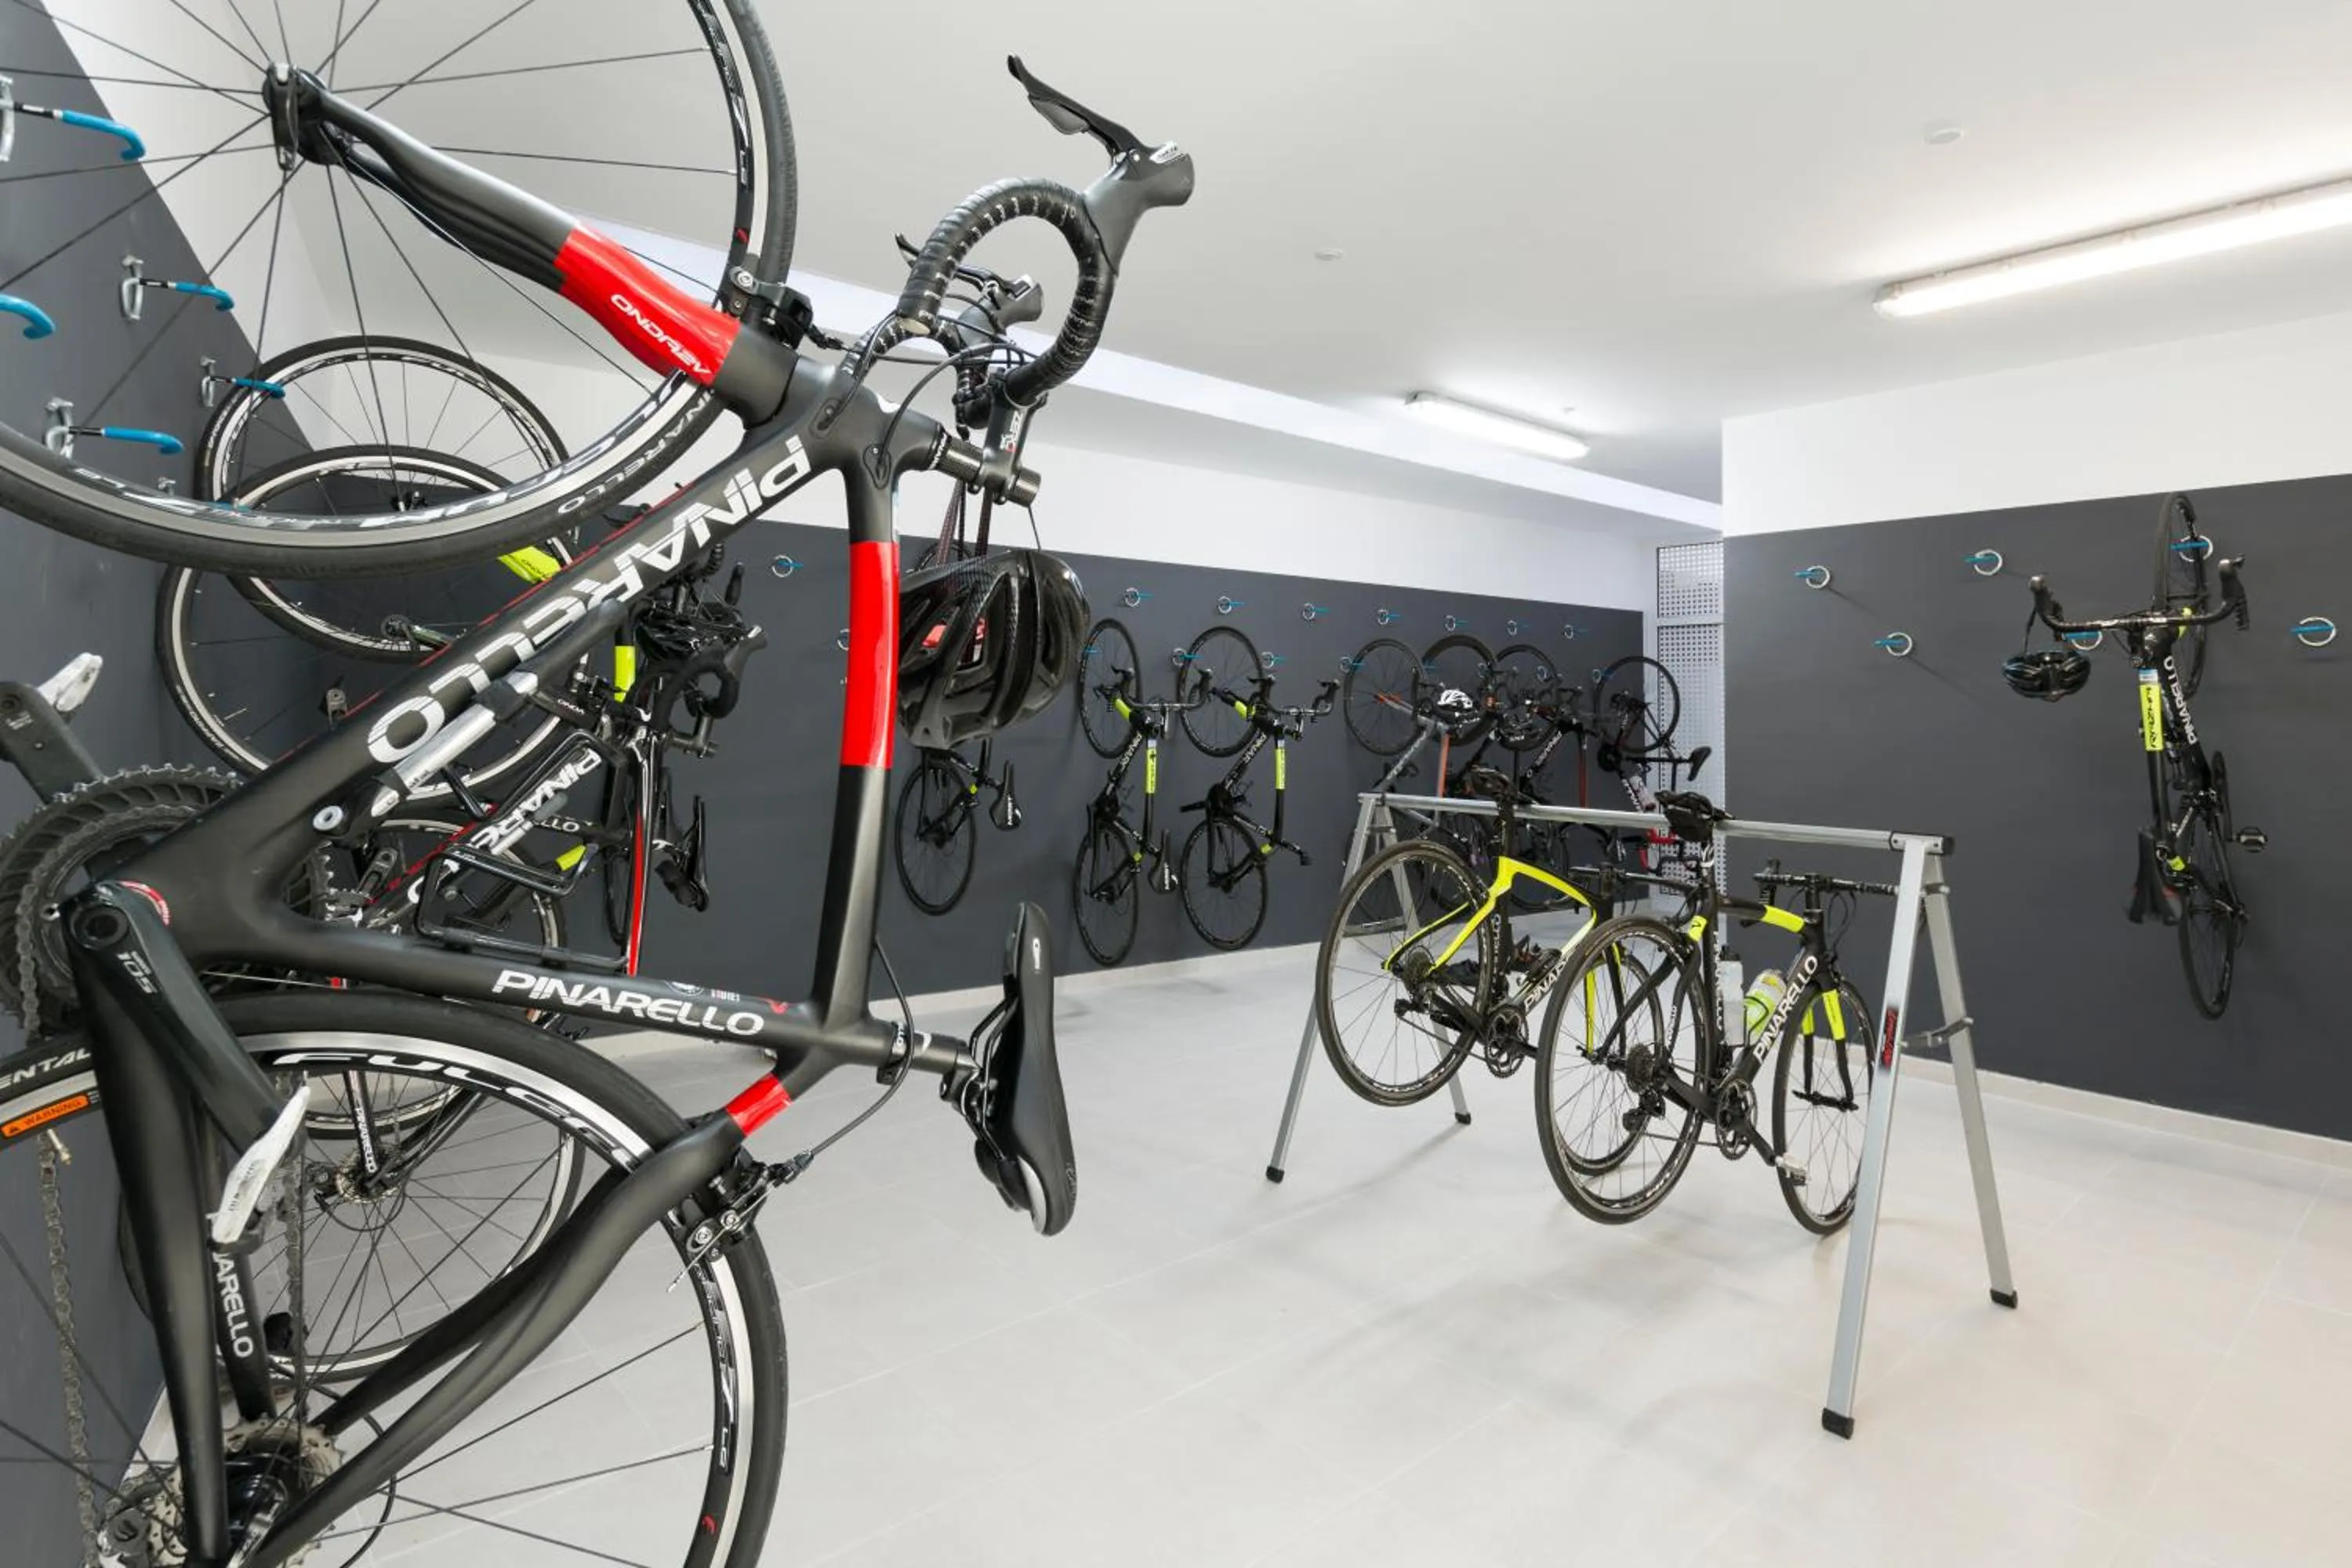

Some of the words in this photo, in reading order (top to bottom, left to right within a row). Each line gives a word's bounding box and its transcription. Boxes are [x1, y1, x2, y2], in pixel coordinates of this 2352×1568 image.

[558, 390, 713, 514] INARELLO
[366, 434, 812, 764] PINARELLO
[117, 952, 158, 993] 105
[491, 968, 765, 1036] PINARELLO
[1752, 955, 1819, 1065] PINARELLO
